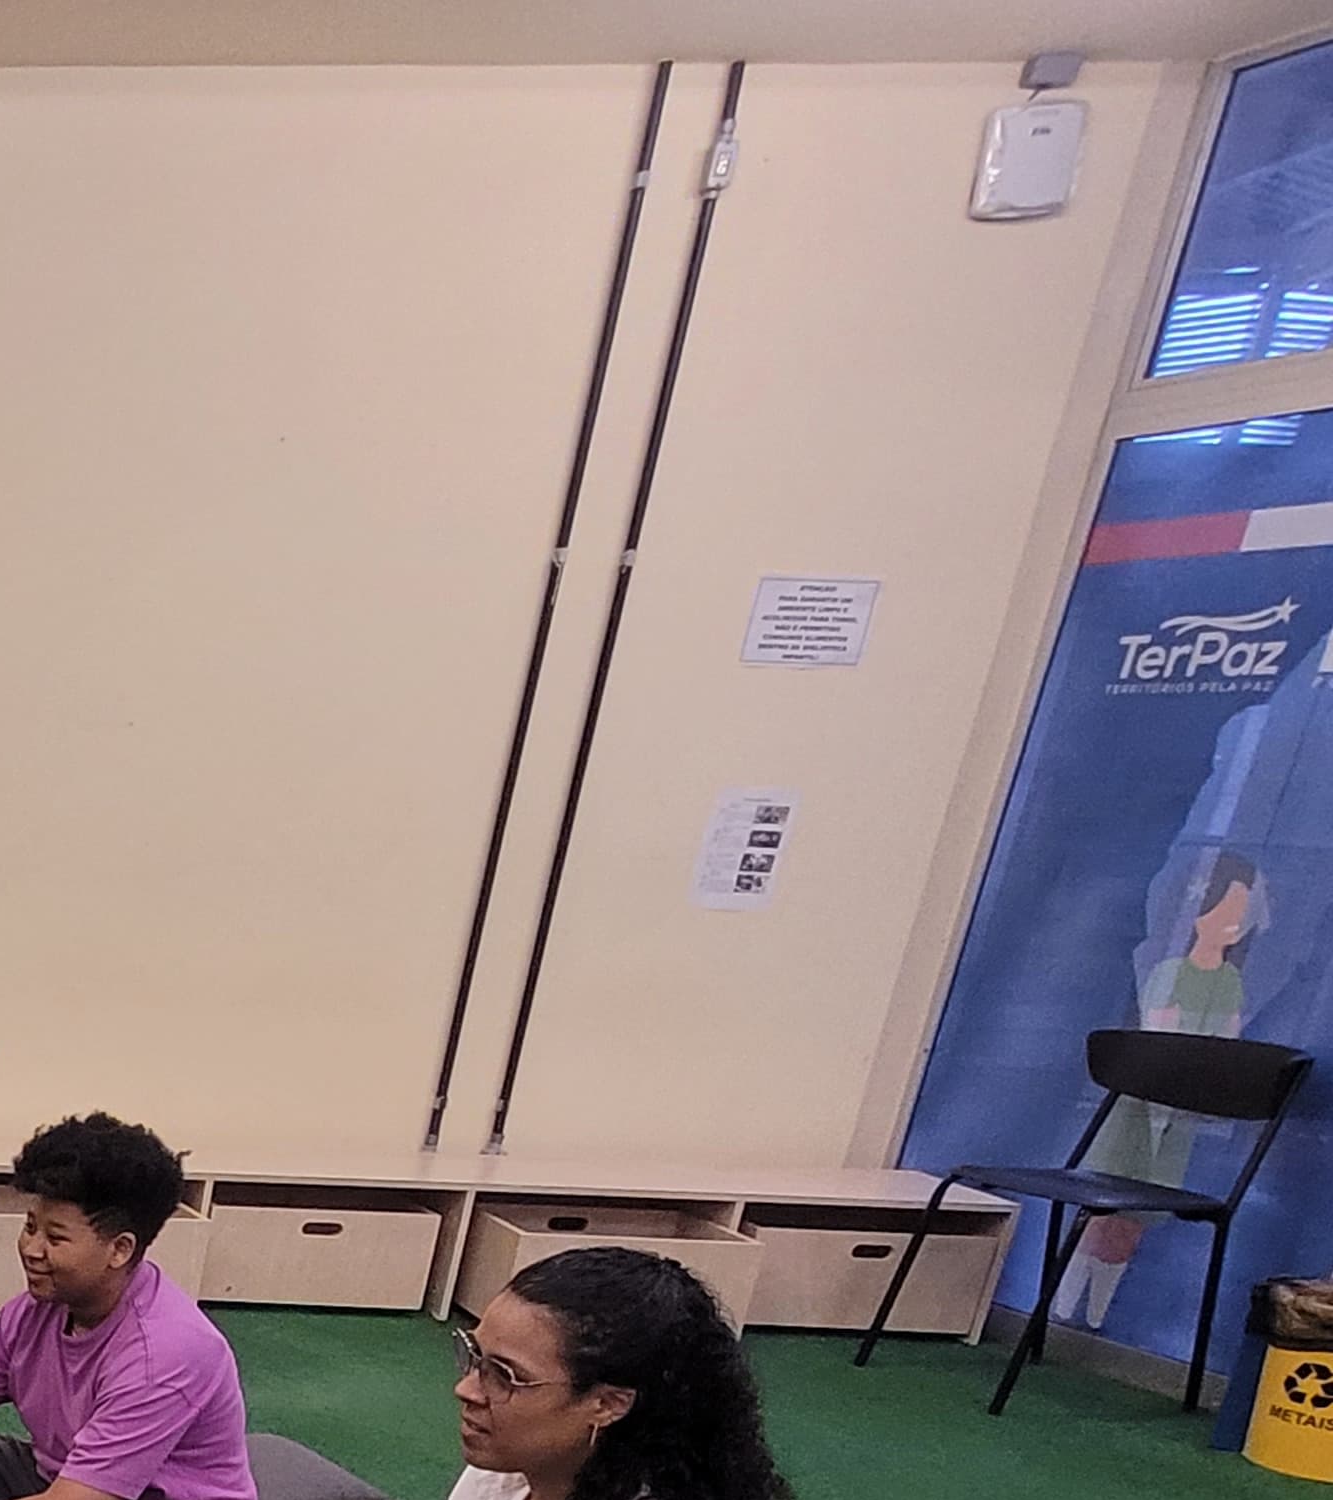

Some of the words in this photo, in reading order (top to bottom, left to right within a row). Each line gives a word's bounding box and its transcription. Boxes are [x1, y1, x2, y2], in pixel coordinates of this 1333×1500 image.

[1119, 631, 1287, 679] TerPaz
[1199, 681, 1236, 693] PELA
[1241, 680, 1275, 692] PAZ
[1269, 1404, 1333, 1431] METAIS
